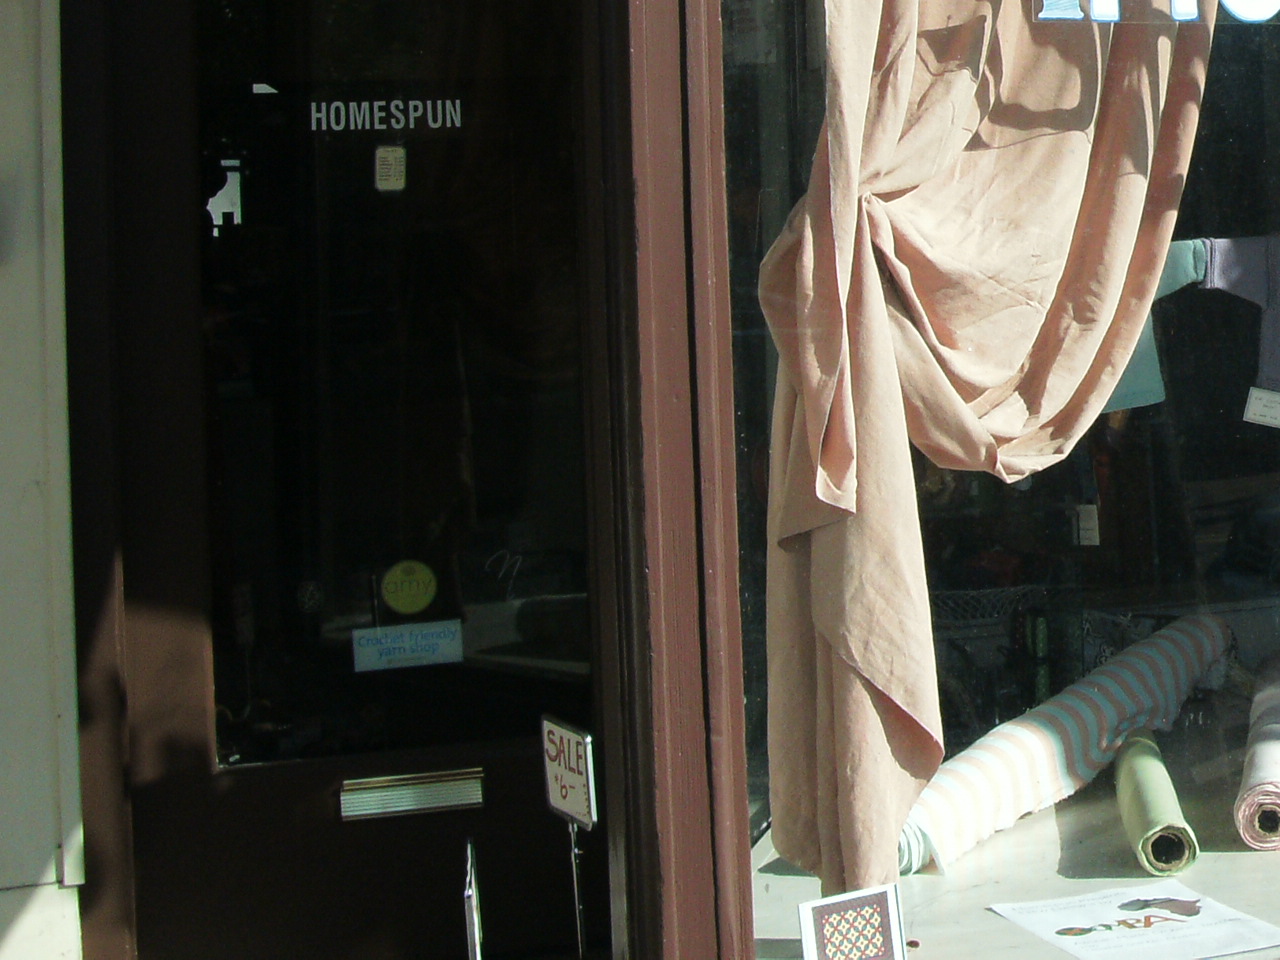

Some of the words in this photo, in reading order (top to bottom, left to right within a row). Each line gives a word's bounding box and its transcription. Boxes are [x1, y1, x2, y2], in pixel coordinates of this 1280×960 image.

[311, 99, 462, 131] HOMESPUN
[409, 627, 458, 645] friendly
[377, 645, 406, 661] yarn
[410, 642, 440, 656] shop
[545, 729, 584, 777] SALE
